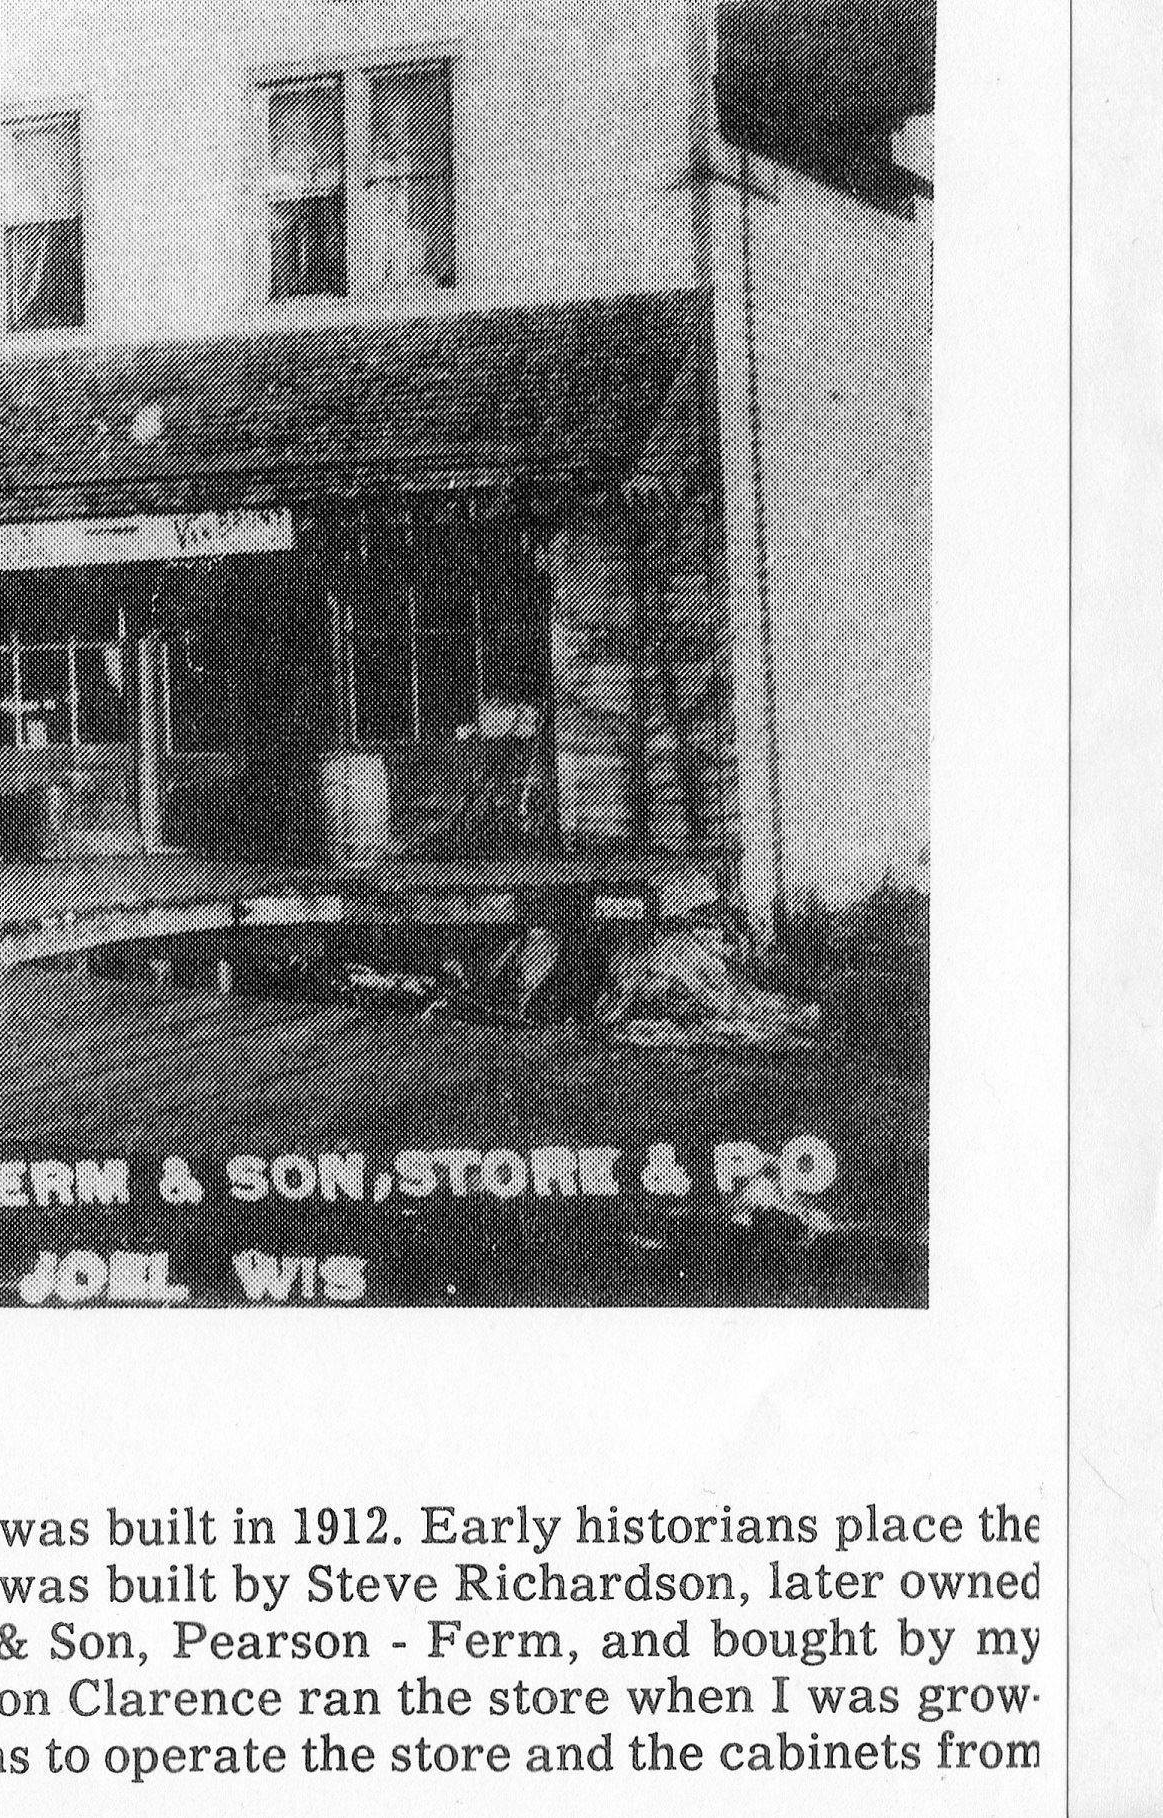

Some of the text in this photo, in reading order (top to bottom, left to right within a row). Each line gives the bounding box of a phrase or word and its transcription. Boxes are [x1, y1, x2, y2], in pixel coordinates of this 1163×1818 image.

[106, 1506, 217, 1547] built
[233, 1507, 276, 1545] in
[293, 1505, 402, 1546] 1912.
[420, 1504, 562, 1555] Early
[576, 1504, 818, 1545] historians
[835, 1503, 963, 1552] place
[978, 1502, 1040, 1544] the
[106, 1563, 217, 1604] built
[231, 1563, 291, 1612] by
[307, 1564, 438, 1603] Steve
[454, 1561, 749, 1608] Richardson,
[768, 1560, 884, 1601] later
[900, 1561, 1040, 1600] owned
[50, 1621, 148, 1667] Son,
[172, 1620, 370, 1660] Pearson
[427, 1620, 578, 1666] Ferm,
[601, 1618, 691, 1659] and
[710, 1616, 878, 1667] bought
[897, 1616, 956, 1666] by
[976, 1627, 1040, 1665] my
[69, 1677, 282, 1717] Clarence
[298, 1687, 381, 1717] ran
[397, 1675, 472, 1716] the
[489, 1679, 609, 1716] store
[626, 1674, 755, 1716] when
[771, 1675, 790, 1714] I
[807, 1685, 900, 1714] was
[45, 1738, 90, 1774] to
[104, 1737, 287, 1784] operate
[301, 1732, 375, 1774] the
[391, 1736, 511, 1773] store
[525, 1732, 614, 1773] and
[628, 1731, 704, 1772] the
[719, 1731, 921, 1772] cabinets
[937, 1729, 1040, 1770] from
